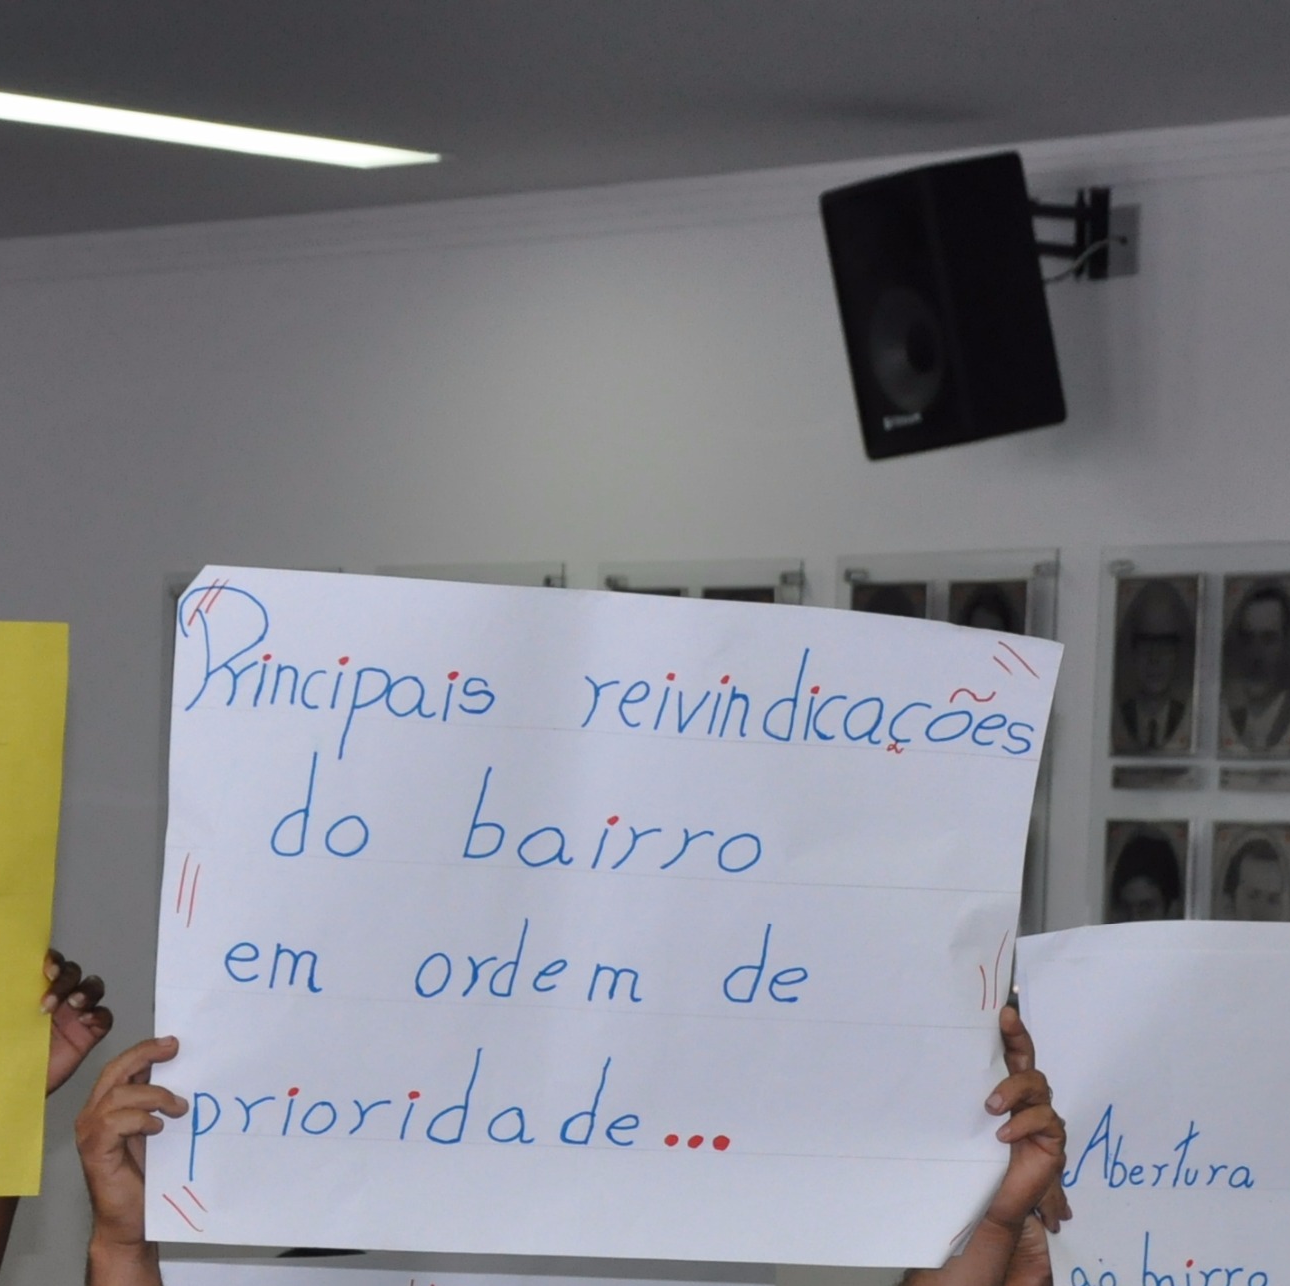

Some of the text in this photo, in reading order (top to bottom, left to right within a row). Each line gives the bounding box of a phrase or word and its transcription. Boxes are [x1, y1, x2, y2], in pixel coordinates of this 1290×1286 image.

[179, 586, 1036, 758] Principais reivindicações
[270, 750, 762, 873] do bairro
[224, 918, 808, 1003] em ordem de
[189, 1047, 730, 1182] prioridade...
[1062, 1104, 1254, 1189] Abertura
